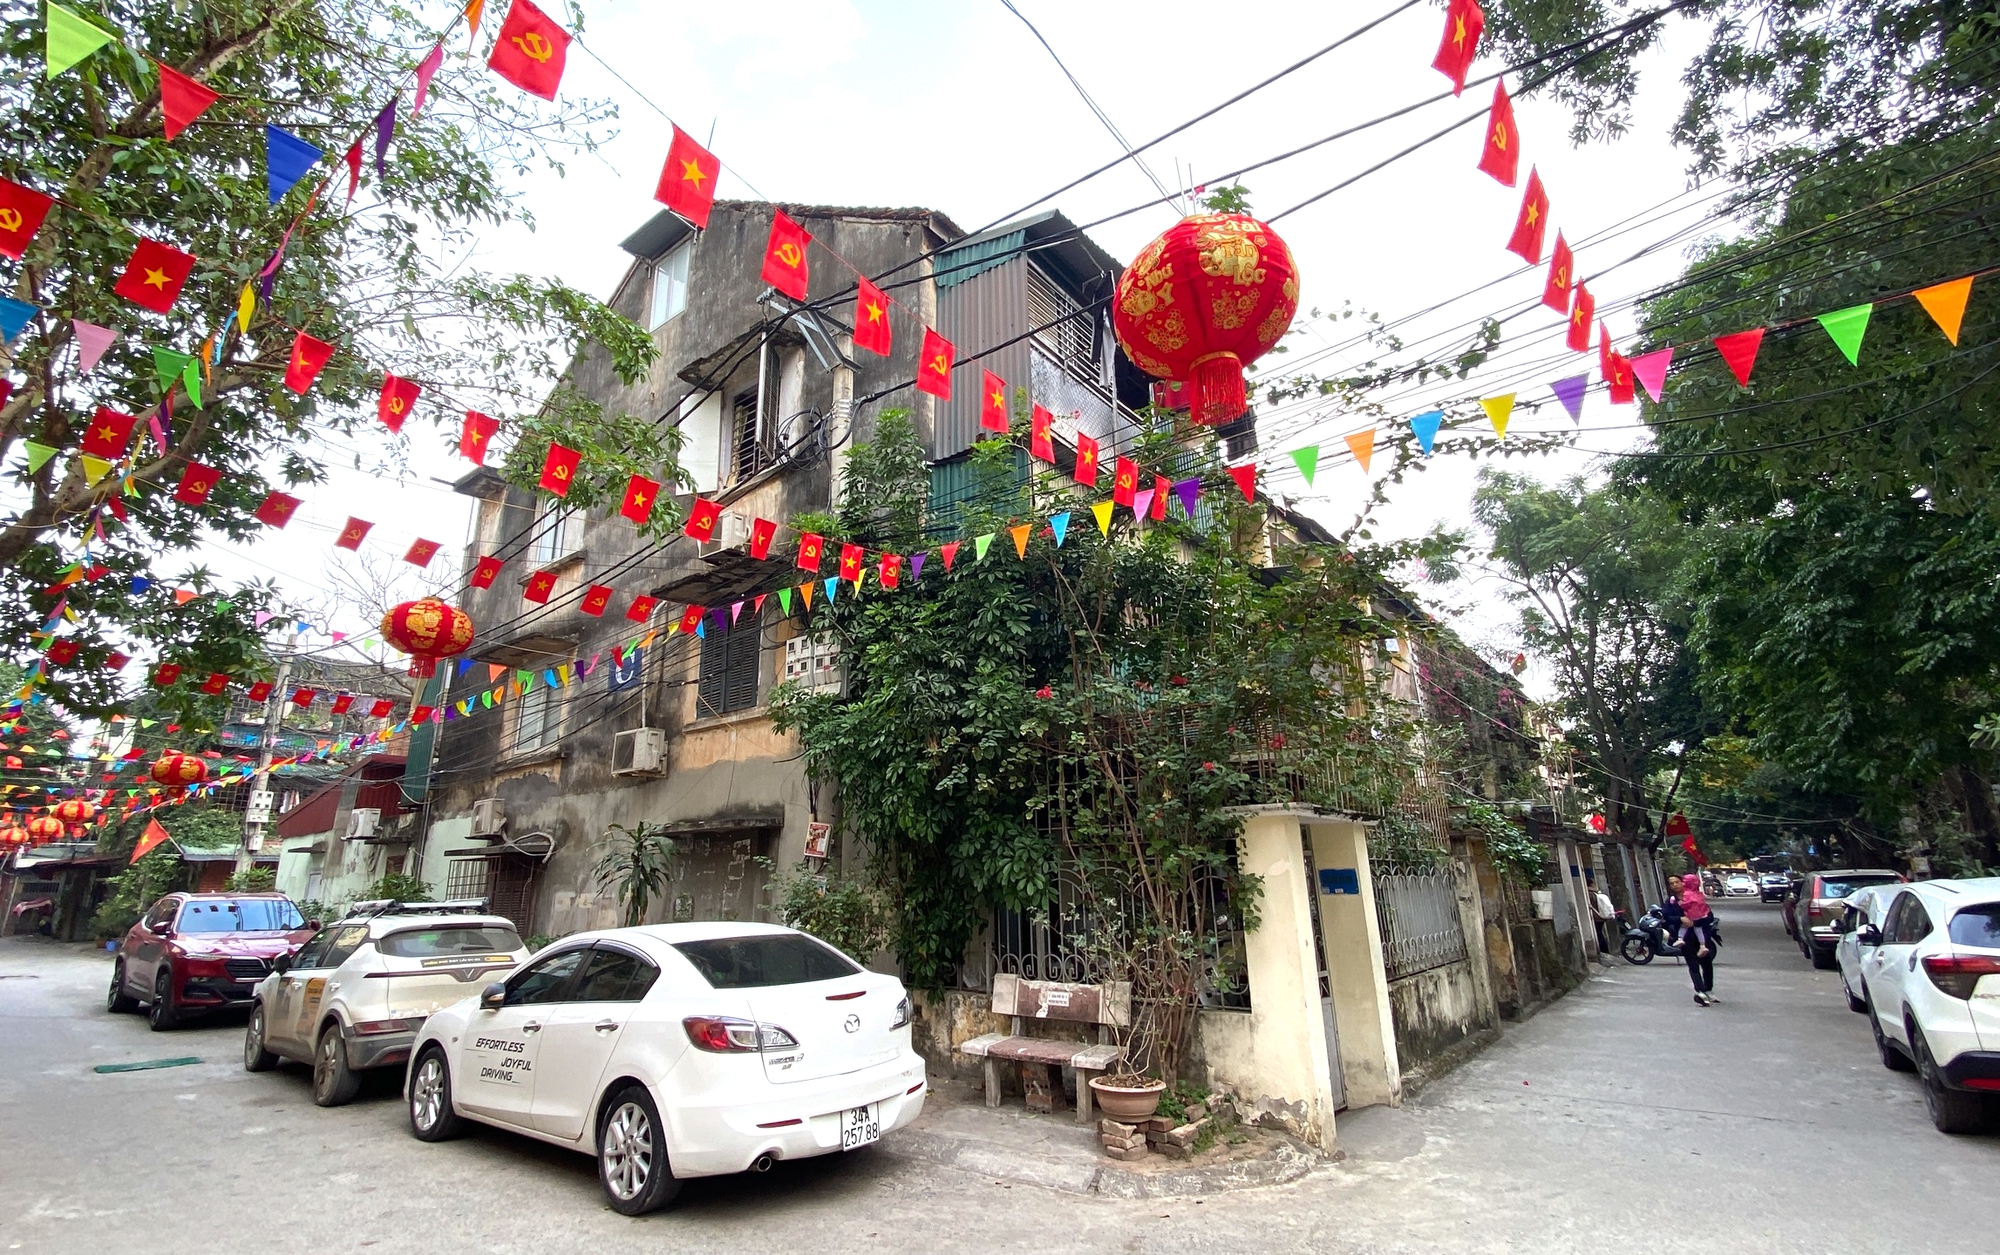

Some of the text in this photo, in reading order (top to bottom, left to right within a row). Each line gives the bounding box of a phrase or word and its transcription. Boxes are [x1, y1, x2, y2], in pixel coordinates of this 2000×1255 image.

[1233, 262, 1267, 287] Lộc
[475, 1037, 525, 1053] EFFORTLESS
[500, 1057, 532, 1071] JOYFUL
[480, 1067, 513, 1081] DRIVING
[851, 1105, 870, 1126] 34A
[844, 1122, 878, 1147] 257.88
